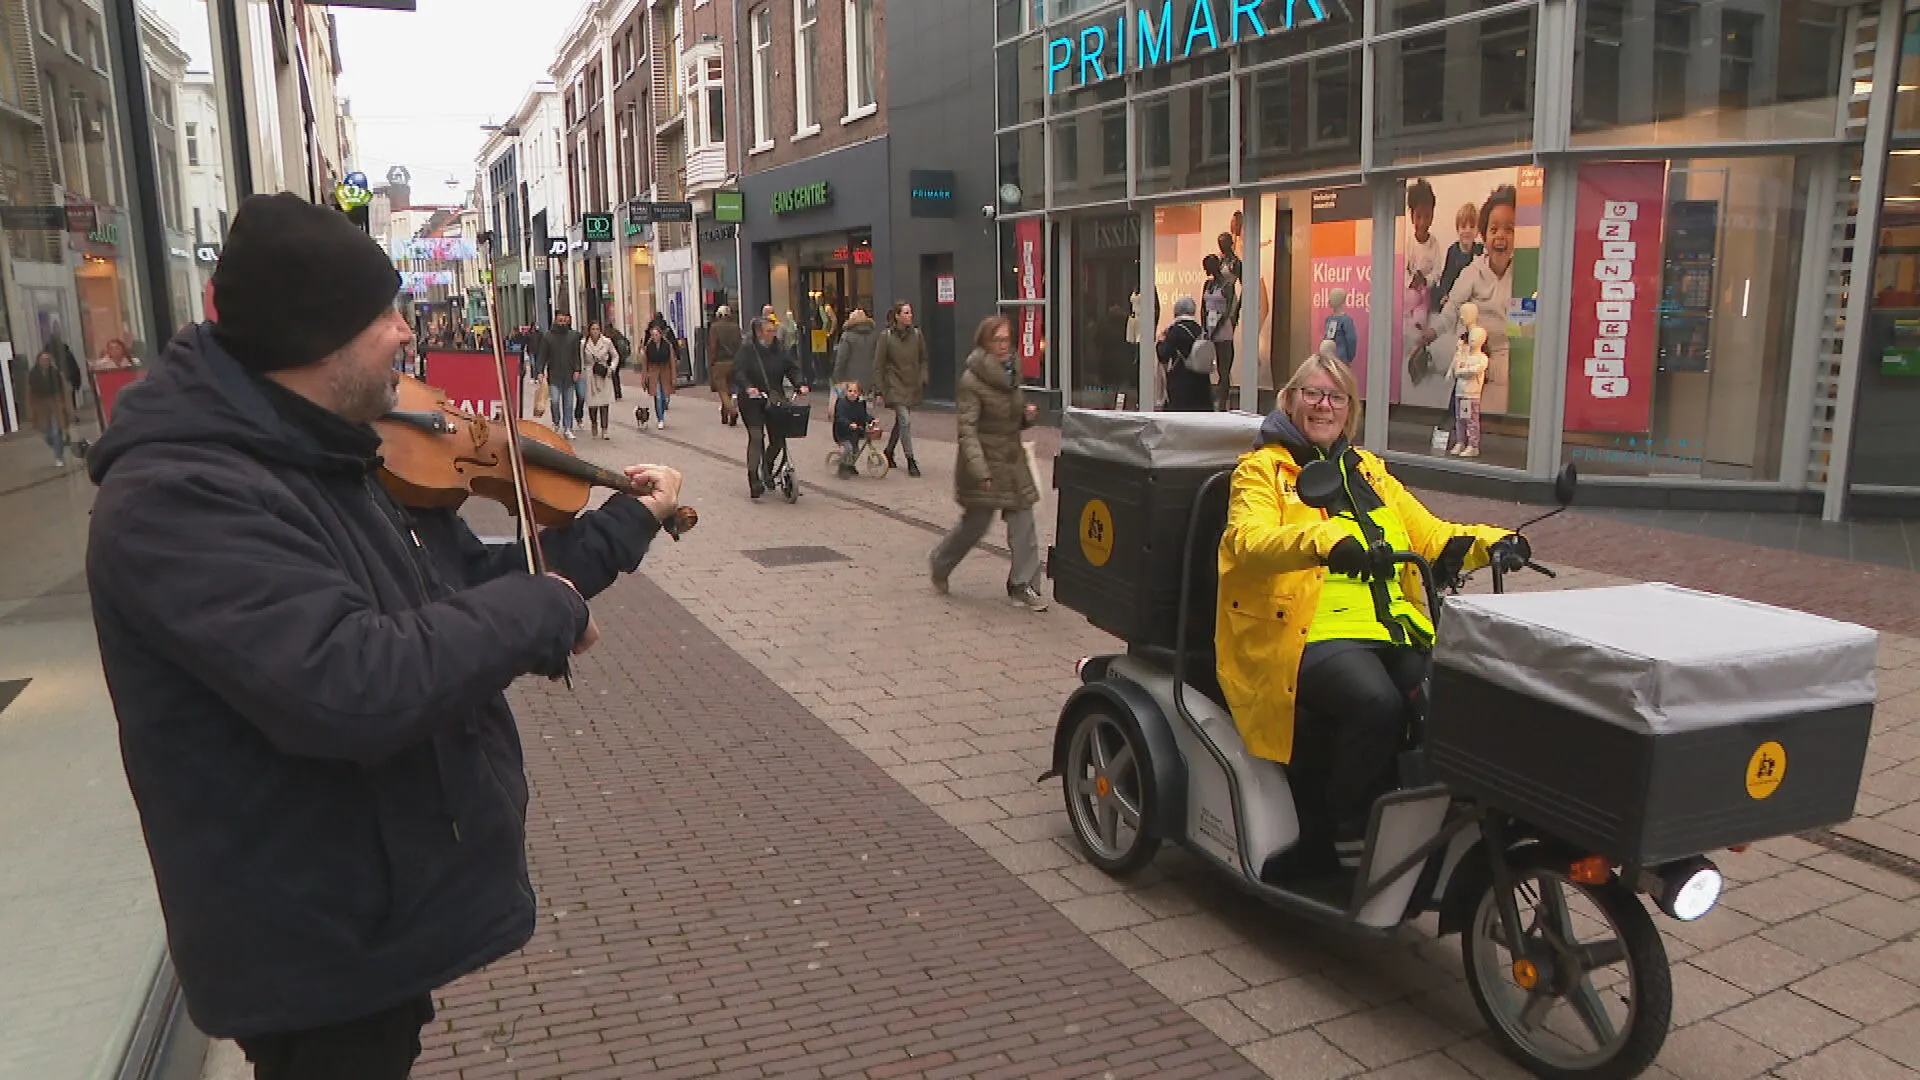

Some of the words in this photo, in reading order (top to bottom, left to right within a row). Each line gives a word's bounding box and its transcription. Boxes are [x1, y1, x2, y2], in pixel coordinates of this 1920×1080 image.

[769, 190, 793, 216] JEANS
[794, 182, 827, 209] CENTRE
[912, 189, 951, 199] PRIMARK
[1313, 262, 1352, 283] Kleur
[1355, 265, 1372, 282] vo
[1594, 203, 1630, 395] AFPRIJZING
